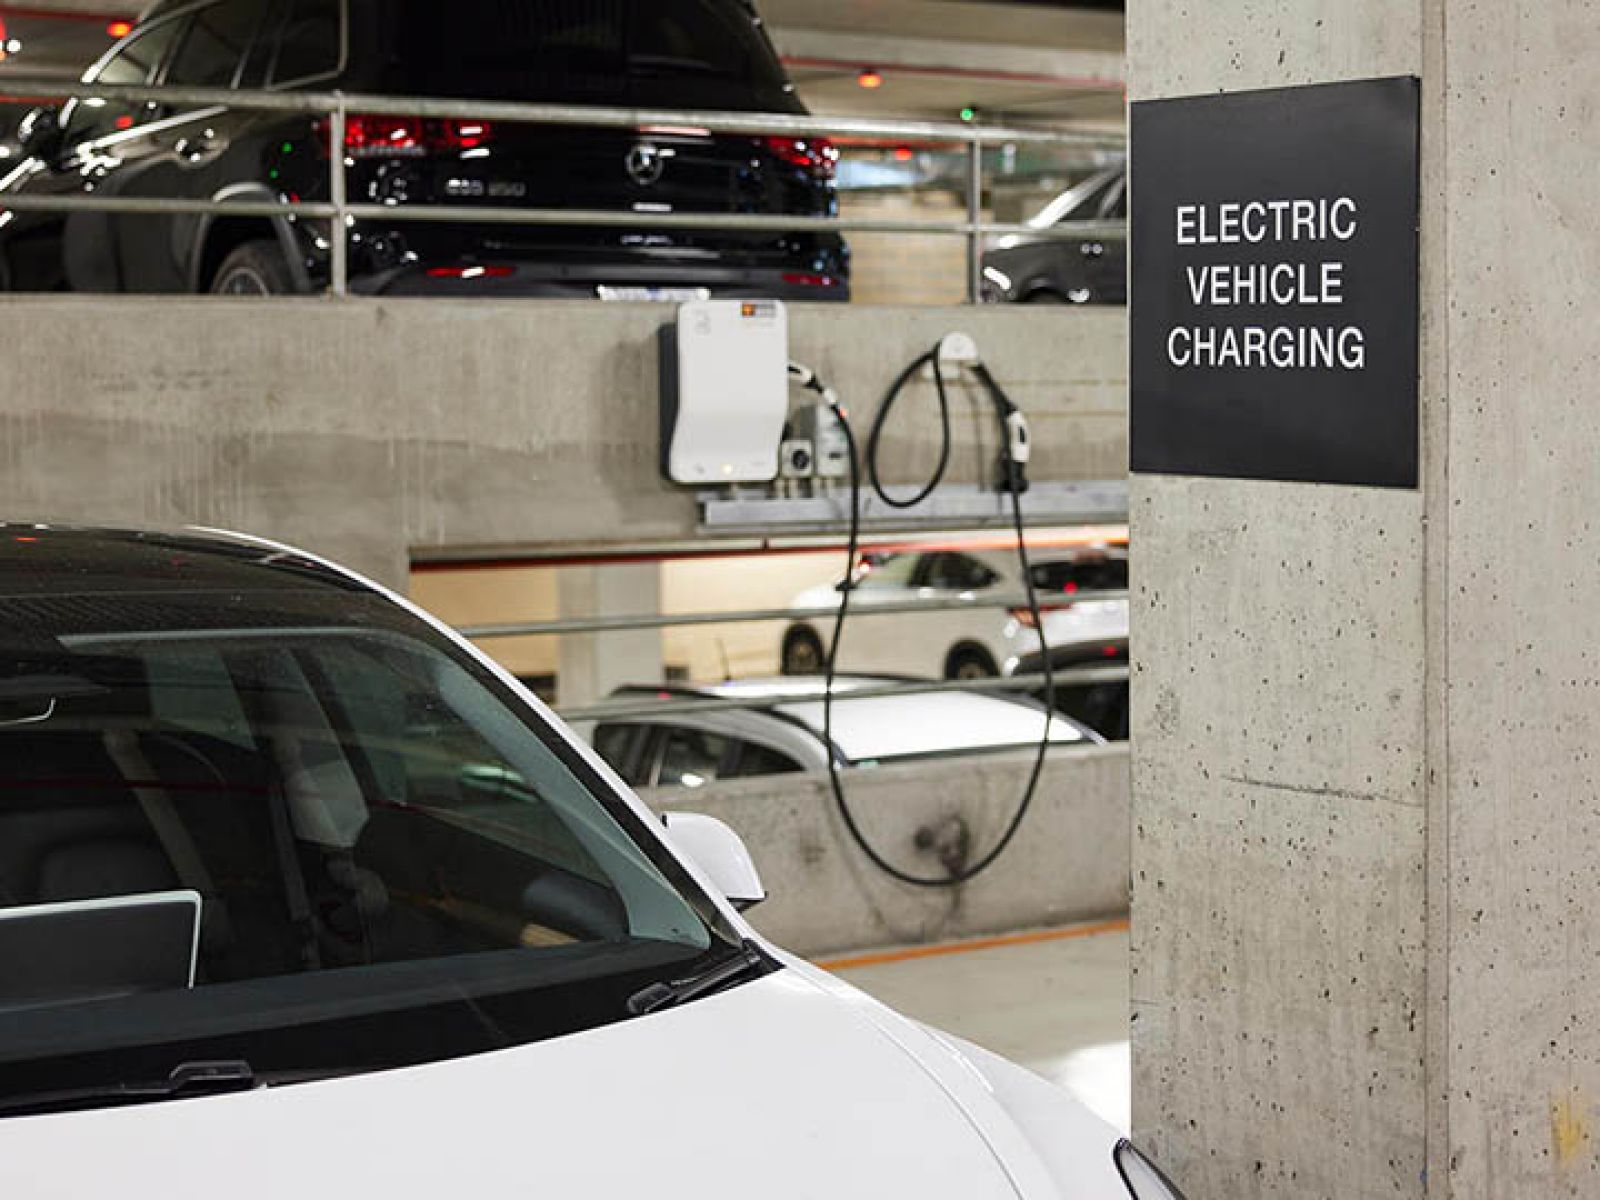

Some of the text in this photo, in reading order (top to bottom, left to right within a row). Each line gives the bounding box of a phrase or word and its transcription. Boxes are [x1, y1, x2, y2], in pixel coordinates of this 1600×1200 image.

[1177, 197, 1356, 244] ELECTRIC
[1187, 263, 1343, 304] VEHICLE
[1168, 326, 1364, 368] CHARGING
